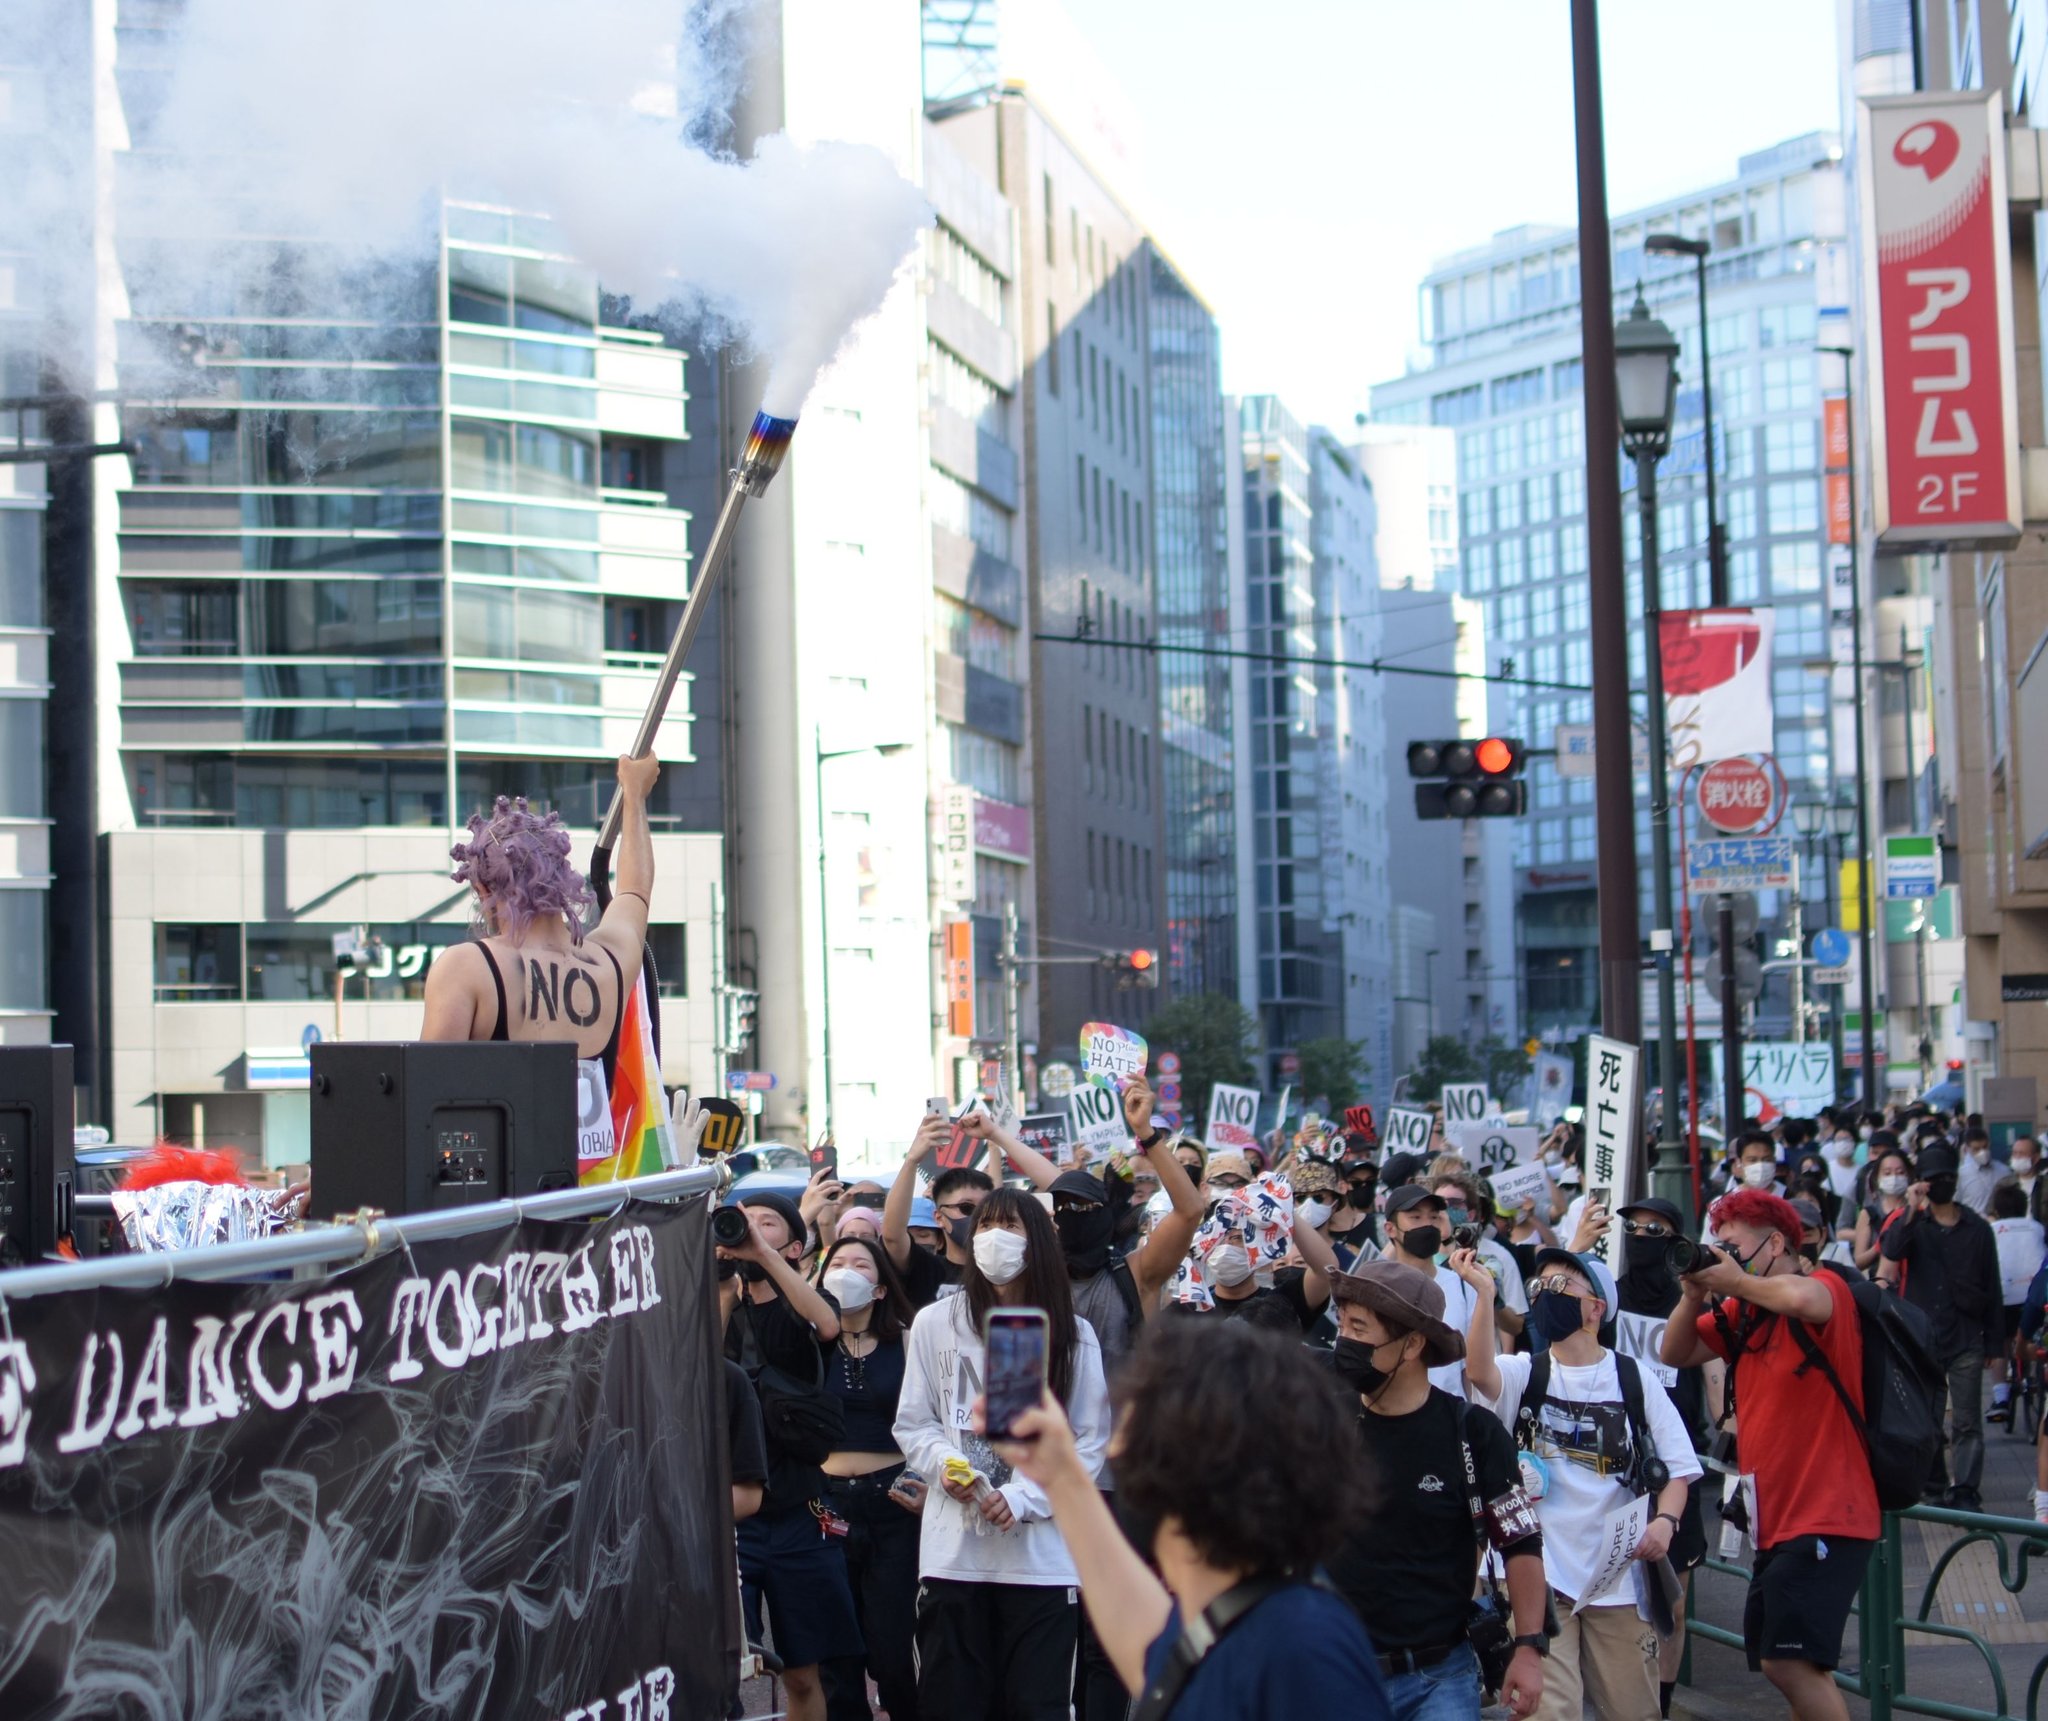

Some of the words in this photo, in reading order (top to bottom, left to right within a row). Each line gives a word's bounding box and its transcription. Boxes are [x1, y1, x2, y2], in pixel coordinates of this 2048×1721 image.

[1907, 267, 1979, 457] アコム
[1918, 472, 1980, 513] 2F
[1705, 780, 1766, 809] 消火栓
[530, 958, 601, 1027] NO
[1092, 1036, 1115, 1053] NO
[1091, 1053, 1136, 1073] HATE
[1074, 1087, 1114, 1129] NO
[1215, 1091, 1254, 1125] NO
[1346, 1107, 1373, 1131] NO
[1446, 1089, 1486, 1121] NO
[578, 1129, 615, 1156] OBIA
[703, 1113, 742, 1154] O!
[1387, 1112, 1427, 1149] NO
[1496, 1180, 1513, 1193] NO
[1513, 1171, 1543, 1187] MORE
[57, 1290, 363, 1453] DANCE
[388, 1225, 662, 1382] TOGETHER
[1462, 1440, 1476, 1484] SONY
[1493, 1497, 1525, 1517] KYODO
[1604, 1519, 1625, 1574] MORE
